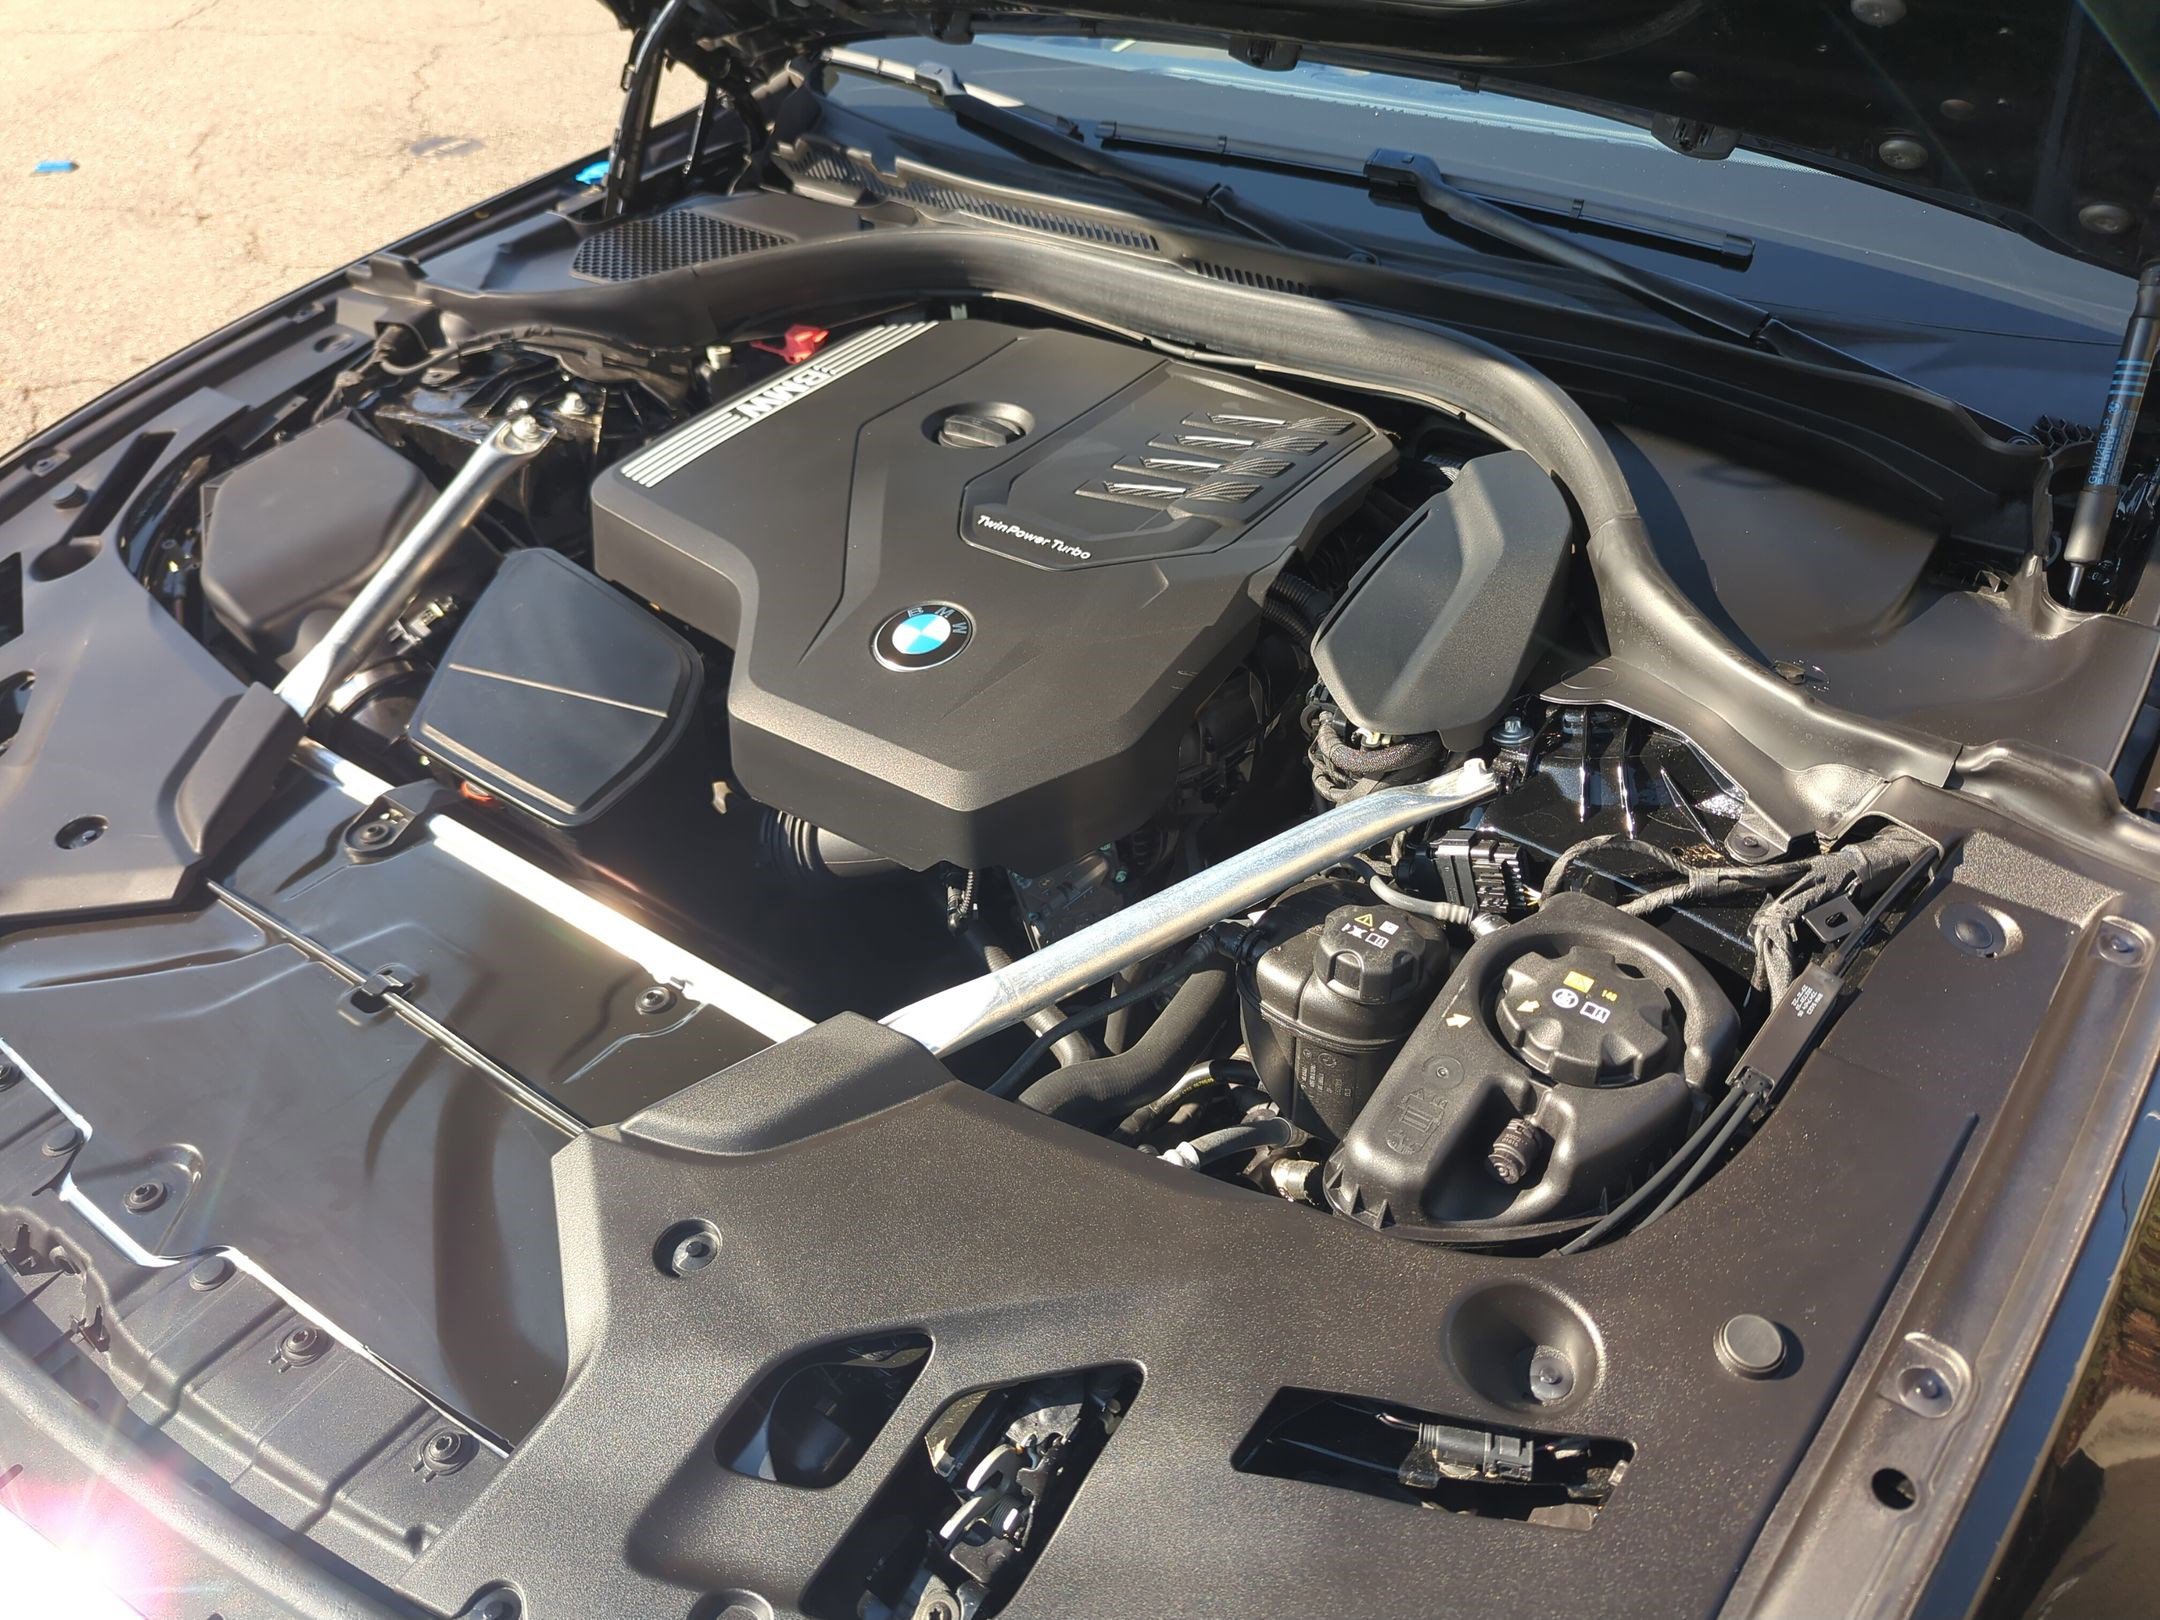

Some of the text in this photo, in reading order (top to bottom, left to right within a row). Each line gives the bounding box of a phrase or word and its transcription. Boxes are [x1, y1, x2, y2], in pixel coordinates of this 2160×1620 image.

[735, 368, 833, 420] BMW
[1051, 539, 1091, 560] Turbo
[907, 606, 968, 634] BMW
